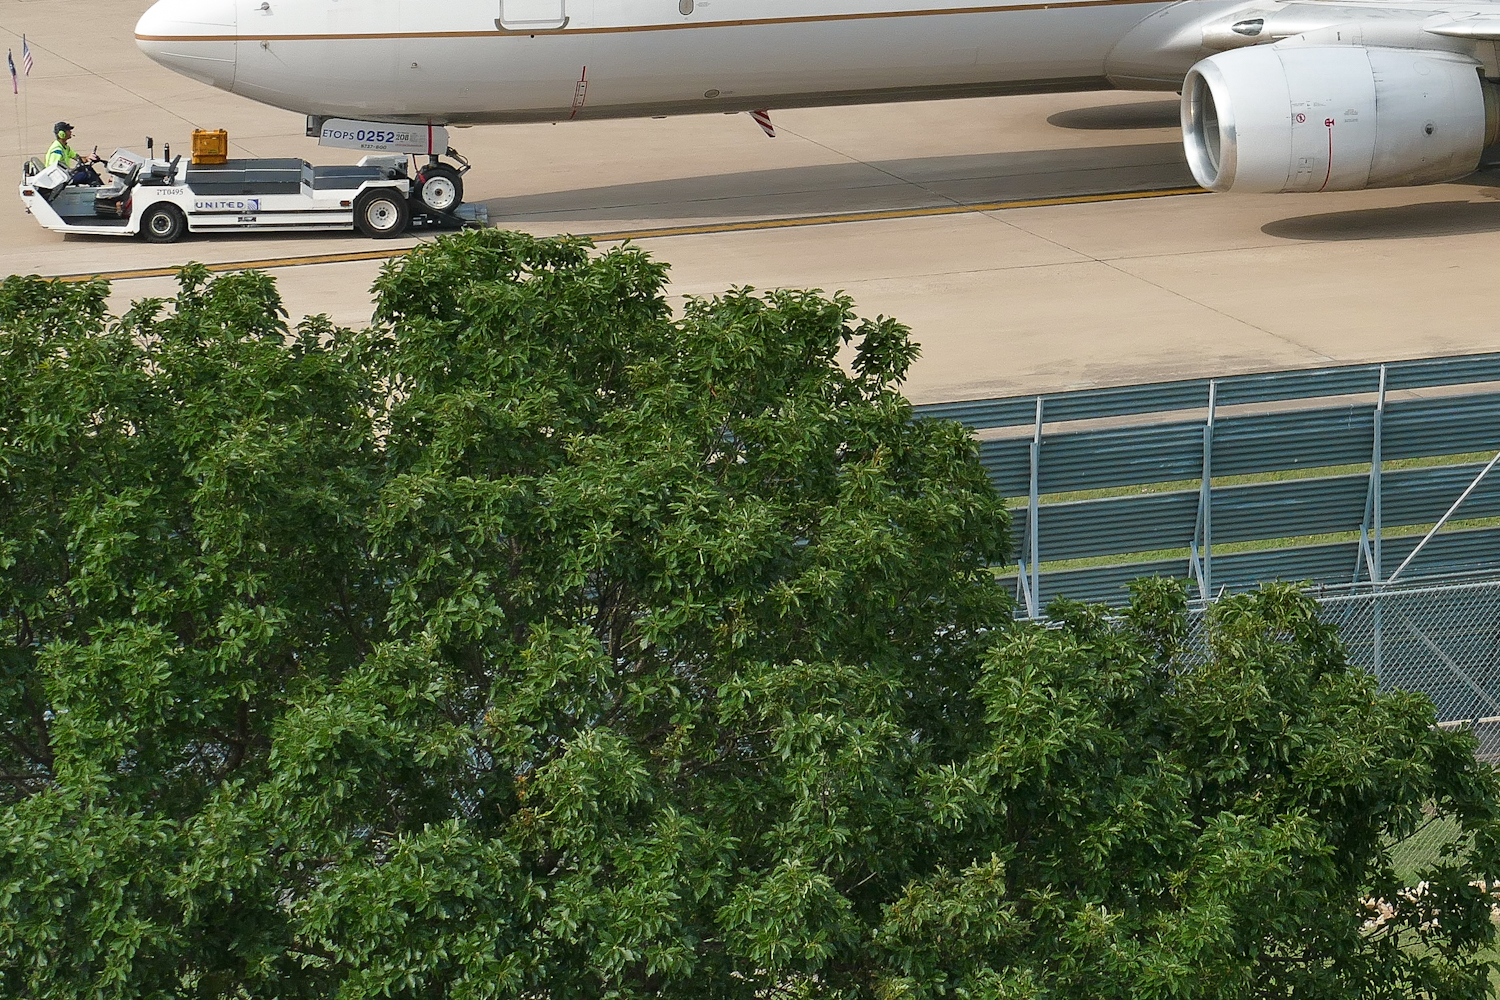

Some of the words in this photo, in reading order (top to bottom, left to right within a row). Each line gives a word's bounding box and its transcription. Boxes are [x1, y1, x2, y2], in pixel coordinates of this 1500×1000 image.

[322, 129, 354, 140] ETOPS
[356, 130, 395, 143] 0252
[195, 201, 244, 209] UNITED
